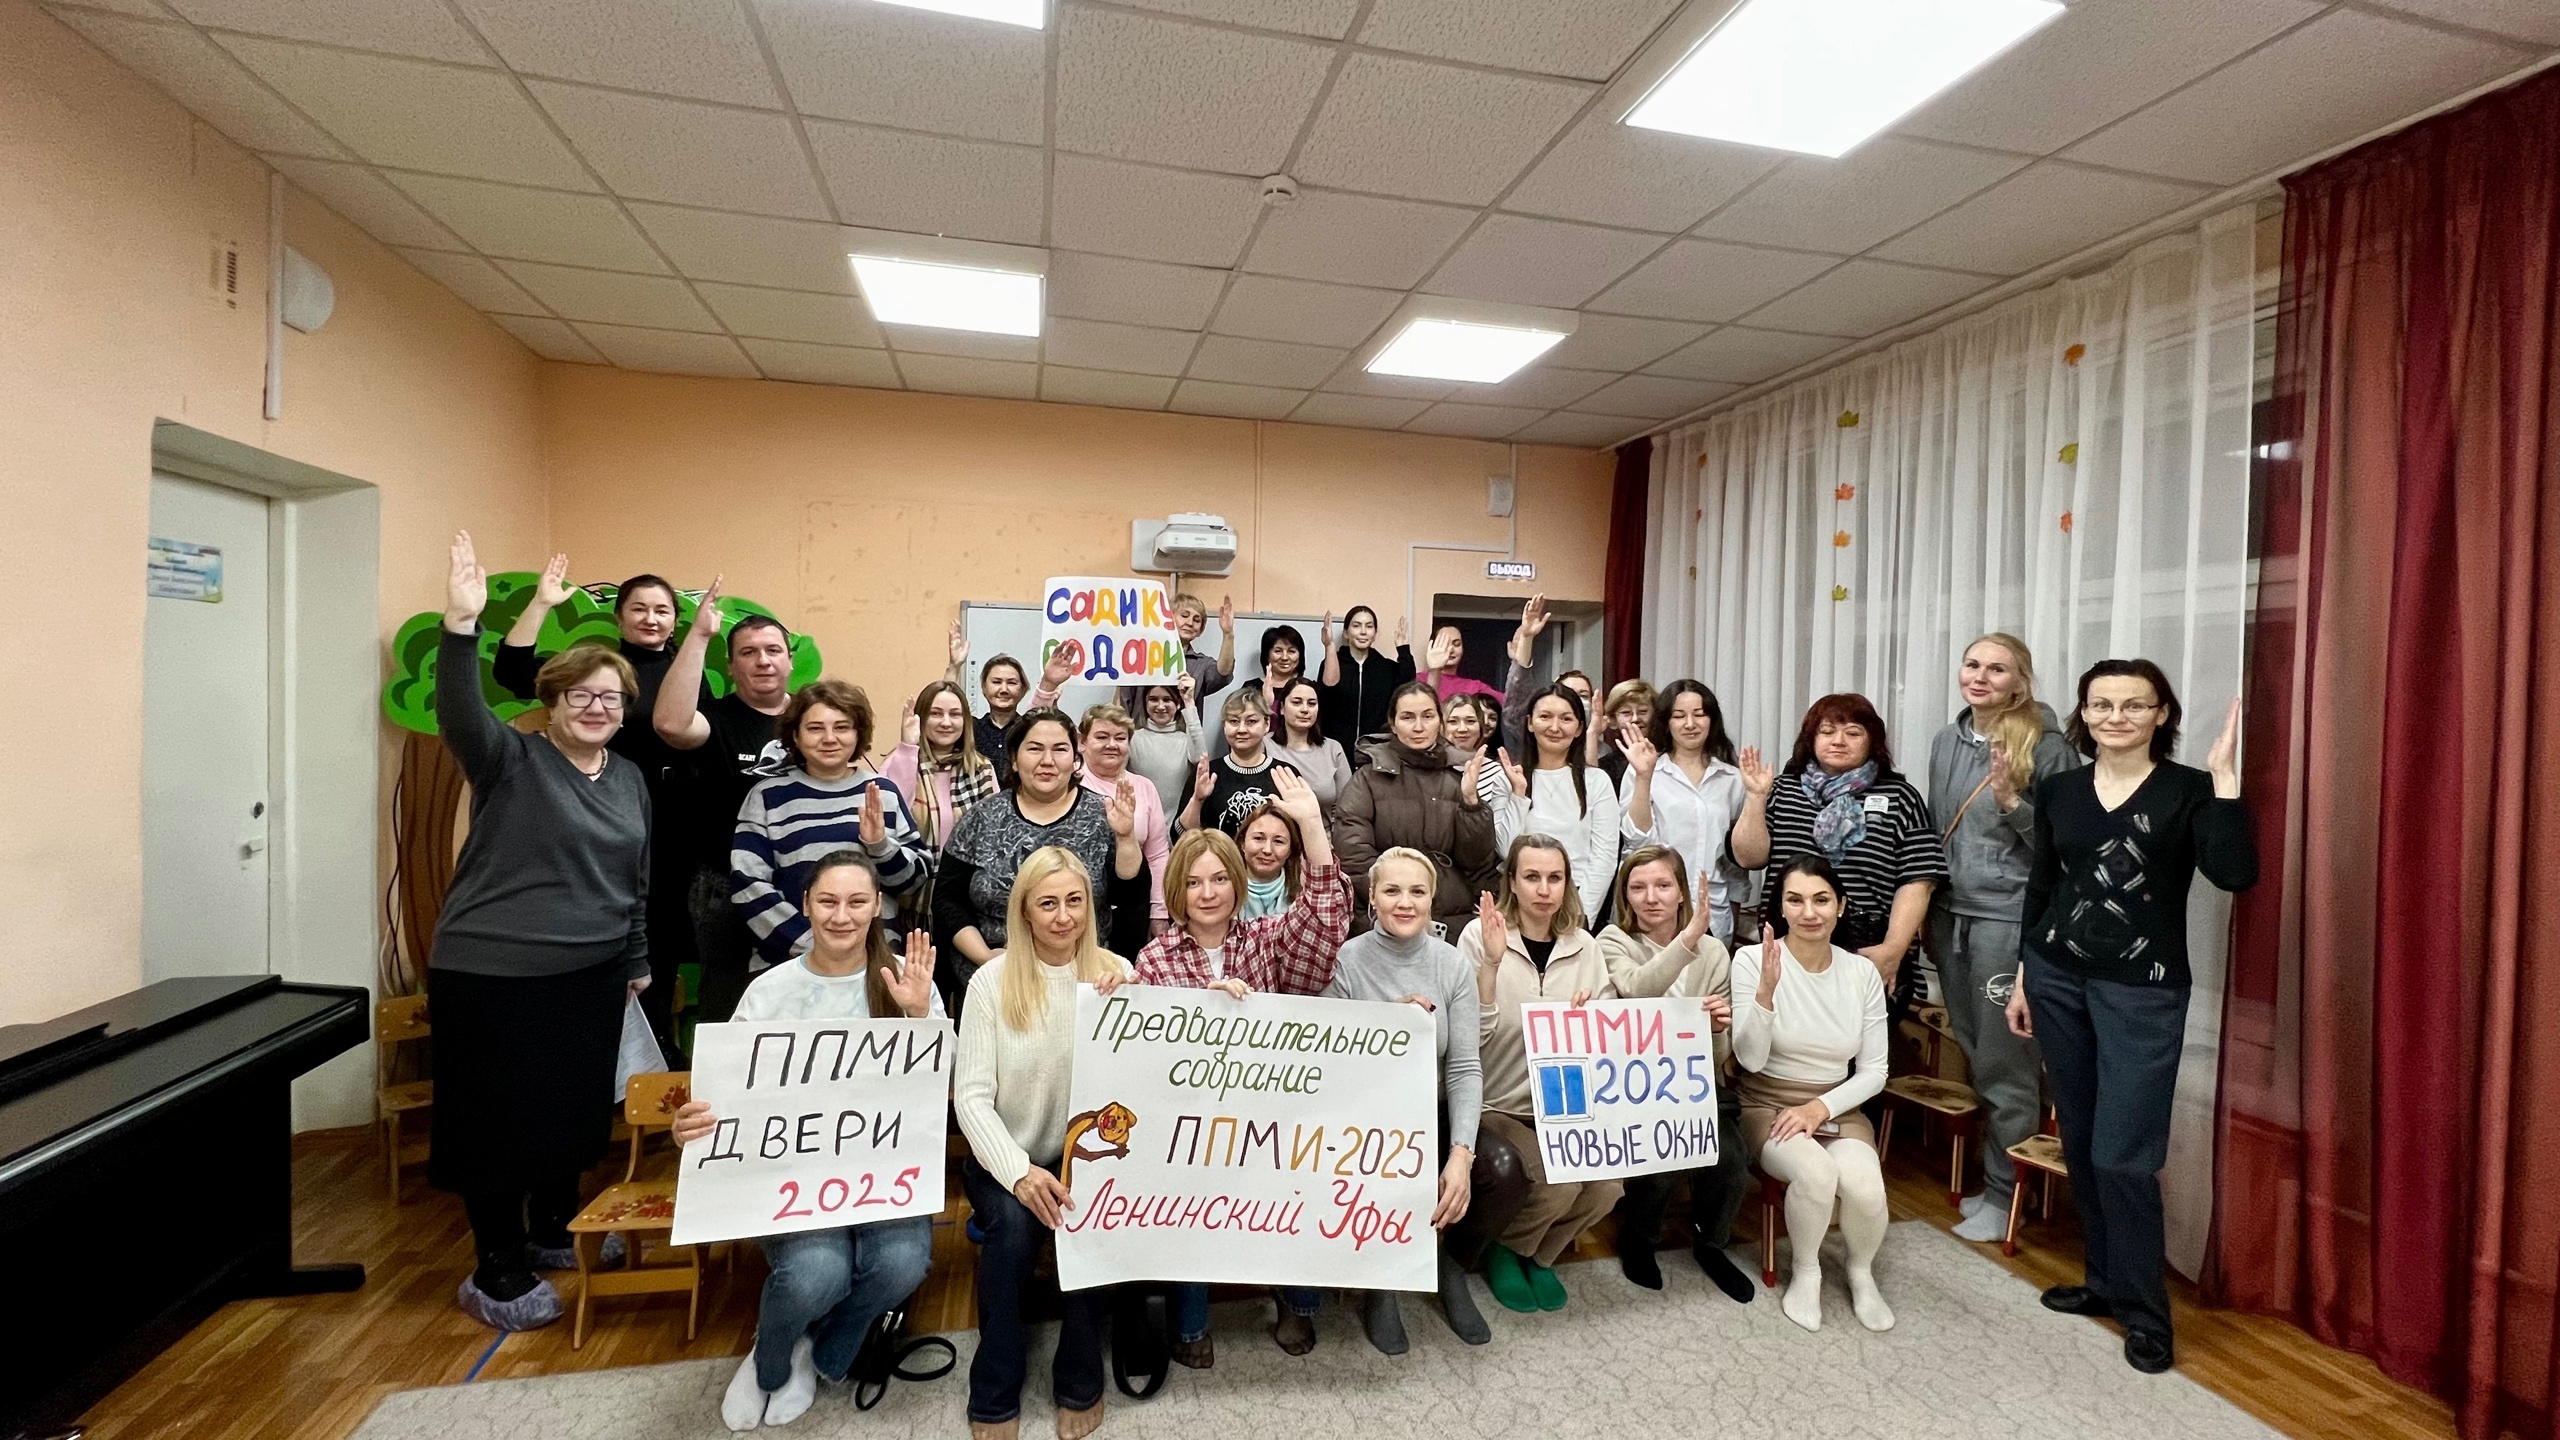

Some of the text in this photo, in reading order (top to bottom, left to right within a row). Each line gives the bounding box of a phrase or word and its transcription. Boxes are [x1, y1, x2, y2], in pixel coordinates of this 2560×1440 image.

[1490, 563, 1531, 576] ВЫХОД
[1092, 997, 1412, 1057] Предварительное
[746, 1029, 943, 1089] ППМИ
[1169, 1049, 1323, 1102] собрание
[1593, 1054, 1710, 1105] 2025
[698, 1110, 903, 1169] ДВЕРИ
[1166, 1115, 1426, 1179] ППМИ-2025
[1545, 1116, 1718, 1168] НОВЫЕ ОКНА
[772, 1166, 922, 1221] 2025
[1065, 1177, 1413, 1251] Ленинский Уфы
